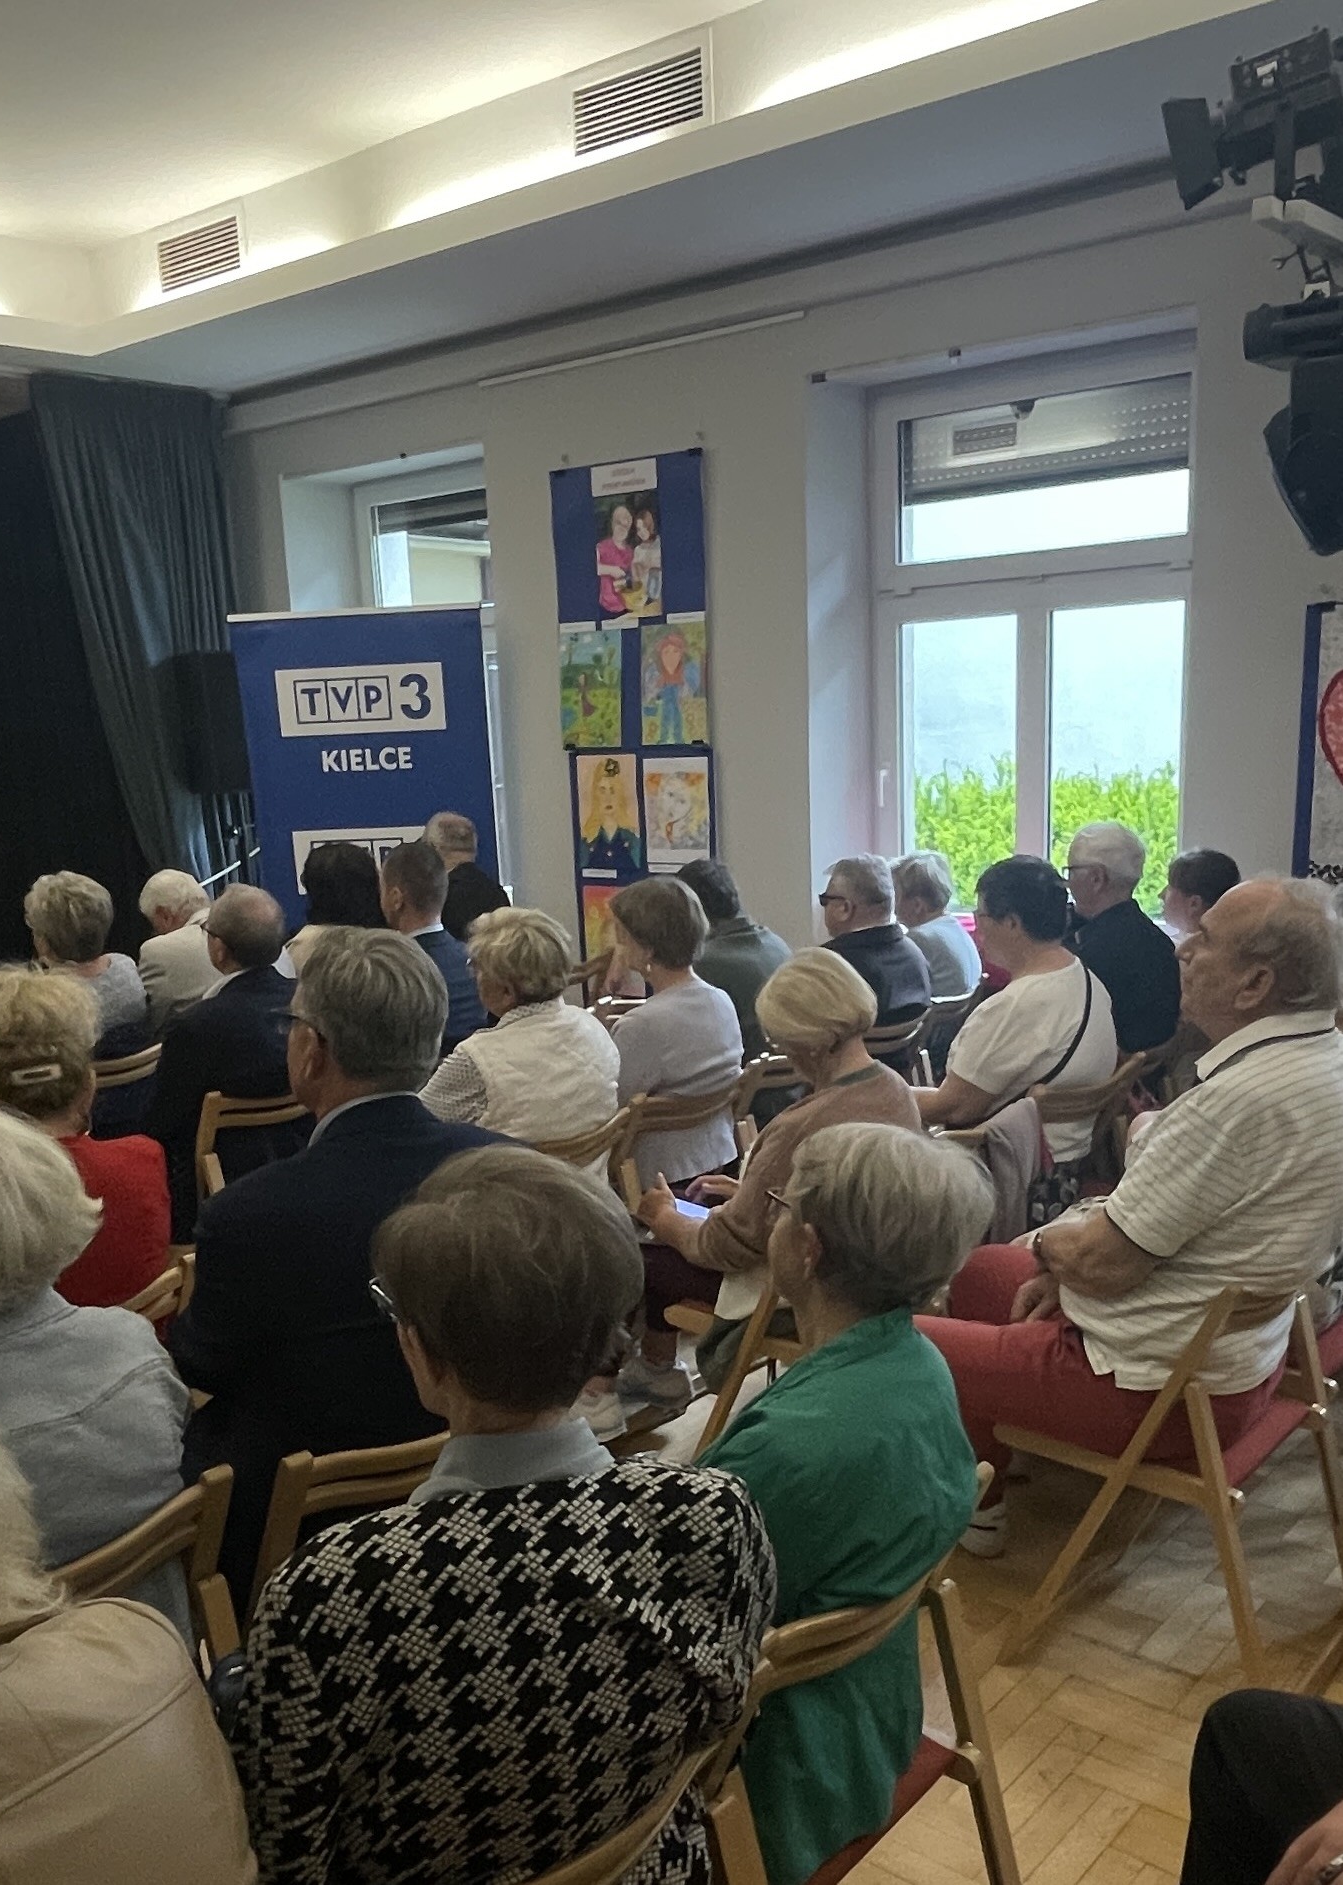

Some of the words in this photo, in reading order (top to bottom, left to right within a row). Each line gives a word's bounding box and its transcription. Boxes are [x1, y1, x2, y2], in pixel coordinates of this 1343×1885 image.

[300, 685, 382, 716] TVP
[399, 673, 431, 719] 3
[321, 747, 413, 773] KIELCE
